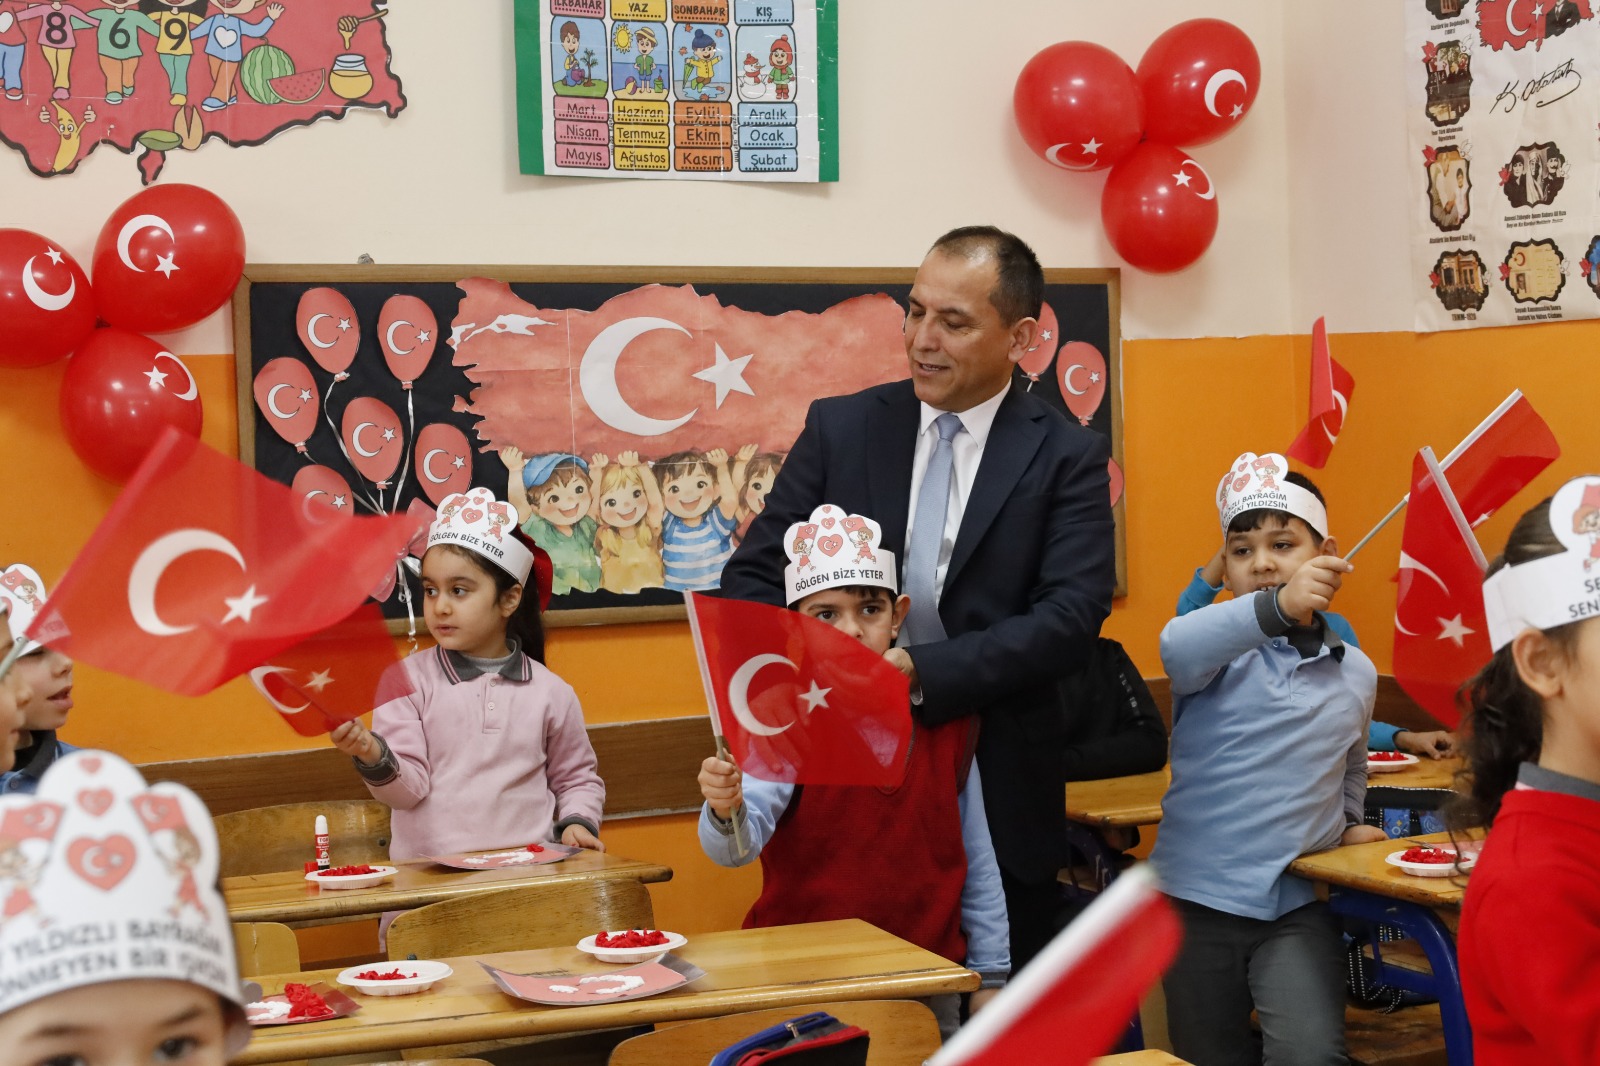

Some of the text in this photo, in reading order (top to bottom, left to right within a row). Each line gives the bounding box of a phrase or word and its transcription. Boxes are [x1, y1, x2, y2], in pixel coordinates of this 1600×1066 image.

[628, 3, 649, 12] YAZ
[673, 5, 726, 17] SONBAHAR
[756, 6, 773, 19] KIŞ
[45, 12, 68, 45] 8
[109, 18, 131, 49] 6
[164, 18, 188, 50] 9
[567, 103, 597, 115] Mart
[617, 105, 664, 118] Haziran
[686, 106, 720, 124] Eylül
[748, 108, 787, 120] Aralık
[566, 124, 599, 138] Nisan
[616, 127, 666, 139] Temmuz
[686, 128, 721, 141] Ekim
[750, 129, 785, 142] Ocak
[565, 148, 603, 164] Mayıs
[620, 151, 666, 167] Ağustos
[683, 152, 725, 166] Kasım
[750, 154, 788, 170] Şubat
[1242, 490, 1287, 503] BAYRAĞIM
[1246, 500, 1288, 510] YILDIZSIN
[460, 533, 480, 546] BİZE
[481, 541, 505, 559] YETER
[795, 567, 884, 592] GÖLGEN BİZE YETER
